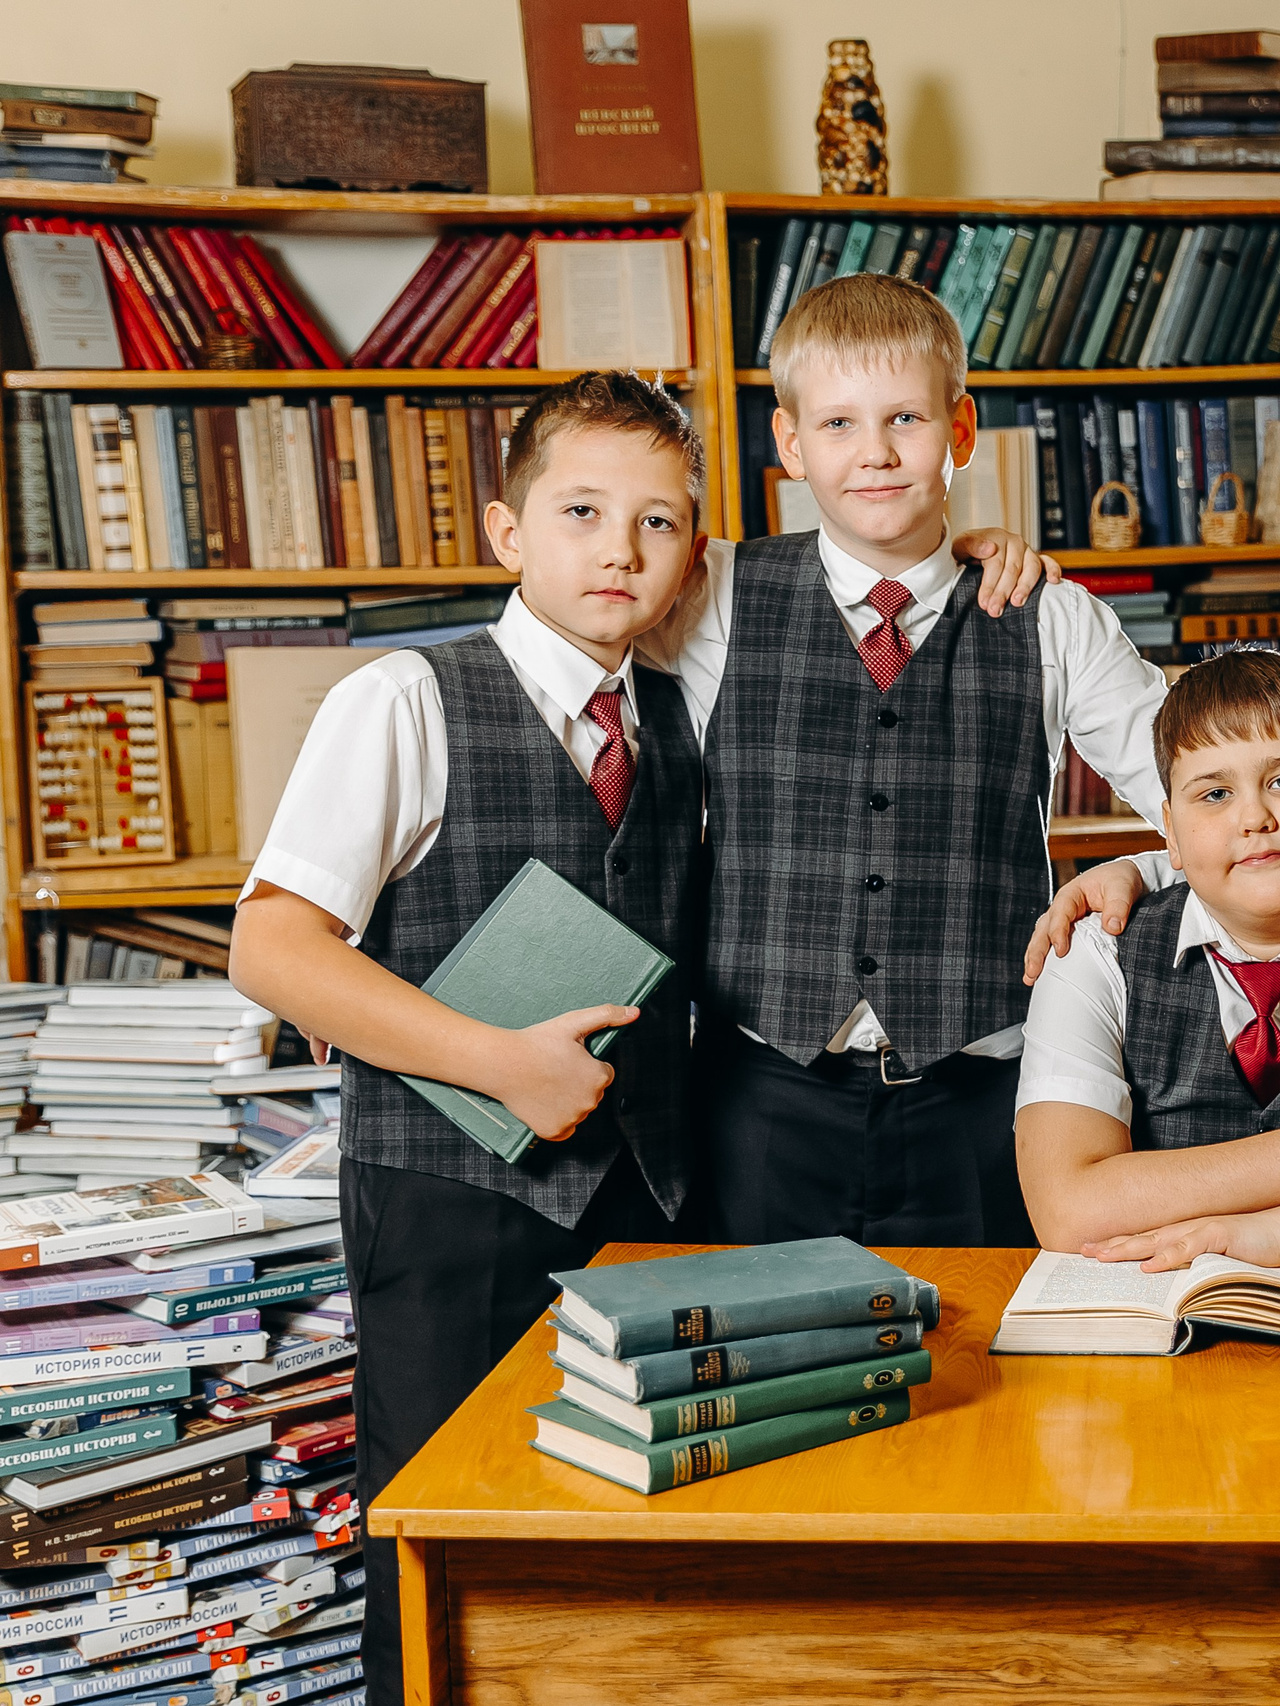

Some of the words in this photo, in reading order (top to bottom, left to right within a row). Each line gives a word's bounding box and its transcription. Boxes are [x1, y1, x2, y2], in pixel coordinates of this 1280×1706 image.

[238, 1217, 247, 1228] 11
[85, 1241, 111, 1250] ИСТОРИЯ
[111, 1238, 134, 1247] РОССИИ
[175, 1303, 189, 1318] 10
[196, 1294, 246, 1311] ИСТОРИЯ
[247, 1282, 305, 1301] ВСЕОБЩАЯ
[873, 1295, 892, 1308] 5
[679, 1319, 691, 1337] С.Т.
[880, 1332, 897, 1345] 4
[35, 1358, 100, 1375] ИСТОРИЯ
[104, 1351, 162, 1368] РОССИИ
[187, 1346, 204, 1361] 11
[276, 1347, 324, 1371] ИСТОРИЯ
[329, 1340, 357, 1355] РОСС
[707, 1351, 721, 1384] КСАКОВ
[697, 1363, 708, 1381] С.Т.
[879, 1374, 889, 1382] 2
[11, 1396, 85, 1416] ВСЕОБЩАЯ
[88, 1386, 150, 1405] ИСТОРИЯ
[74, 1432, 137, 1453] ИСТОРИЯ
[693, 1447, 701, 1474] СЕРГЕЙ
[11, 1512, 30, 1532] 11
[114, 1483, 162, 1502] ВСЕОБЩАЯ
[163, 1472, 203, 1490] ИСТОРИЯ
[12, 1540, 30, 1560] 11
[65, 1527, 103, 1542] Загладин
[114, 1509, 163, 1530] ВСЕОБЩАЯ
[163, 1500, 204, 1517] ИСТОРИЯ
[248, 1541, 300, 1562] РОССИИ
[0, 1590, 25, 1604] РОС
[29, 1578, 95, 1599] ИСТОРИЯ
[25, 1615, 83, 1635] РОССИИ
[109, 1606, 128, 1622] 11
[120, 1618, 182, 1643] ИСТОРИЯ
[185, 1602, 238, 1626] РОССИИ
[260, 1590, 278, 1606] 11
[260, 1660, 274, 1669] 7
[296, 1644, 340, 1661] ИСТОРИЯ
[17, 1665, 34, 1676] 6
[24, 1694, 42, 1706] 6
[73, 1670, 136, 1697] ИСТОРИЯ
[140, 1660, 192, 1683] РОССИИ
[267, 1691, 281, 1702] 6
[301, 1671, 351, 1693] ИСТОРИЯ
